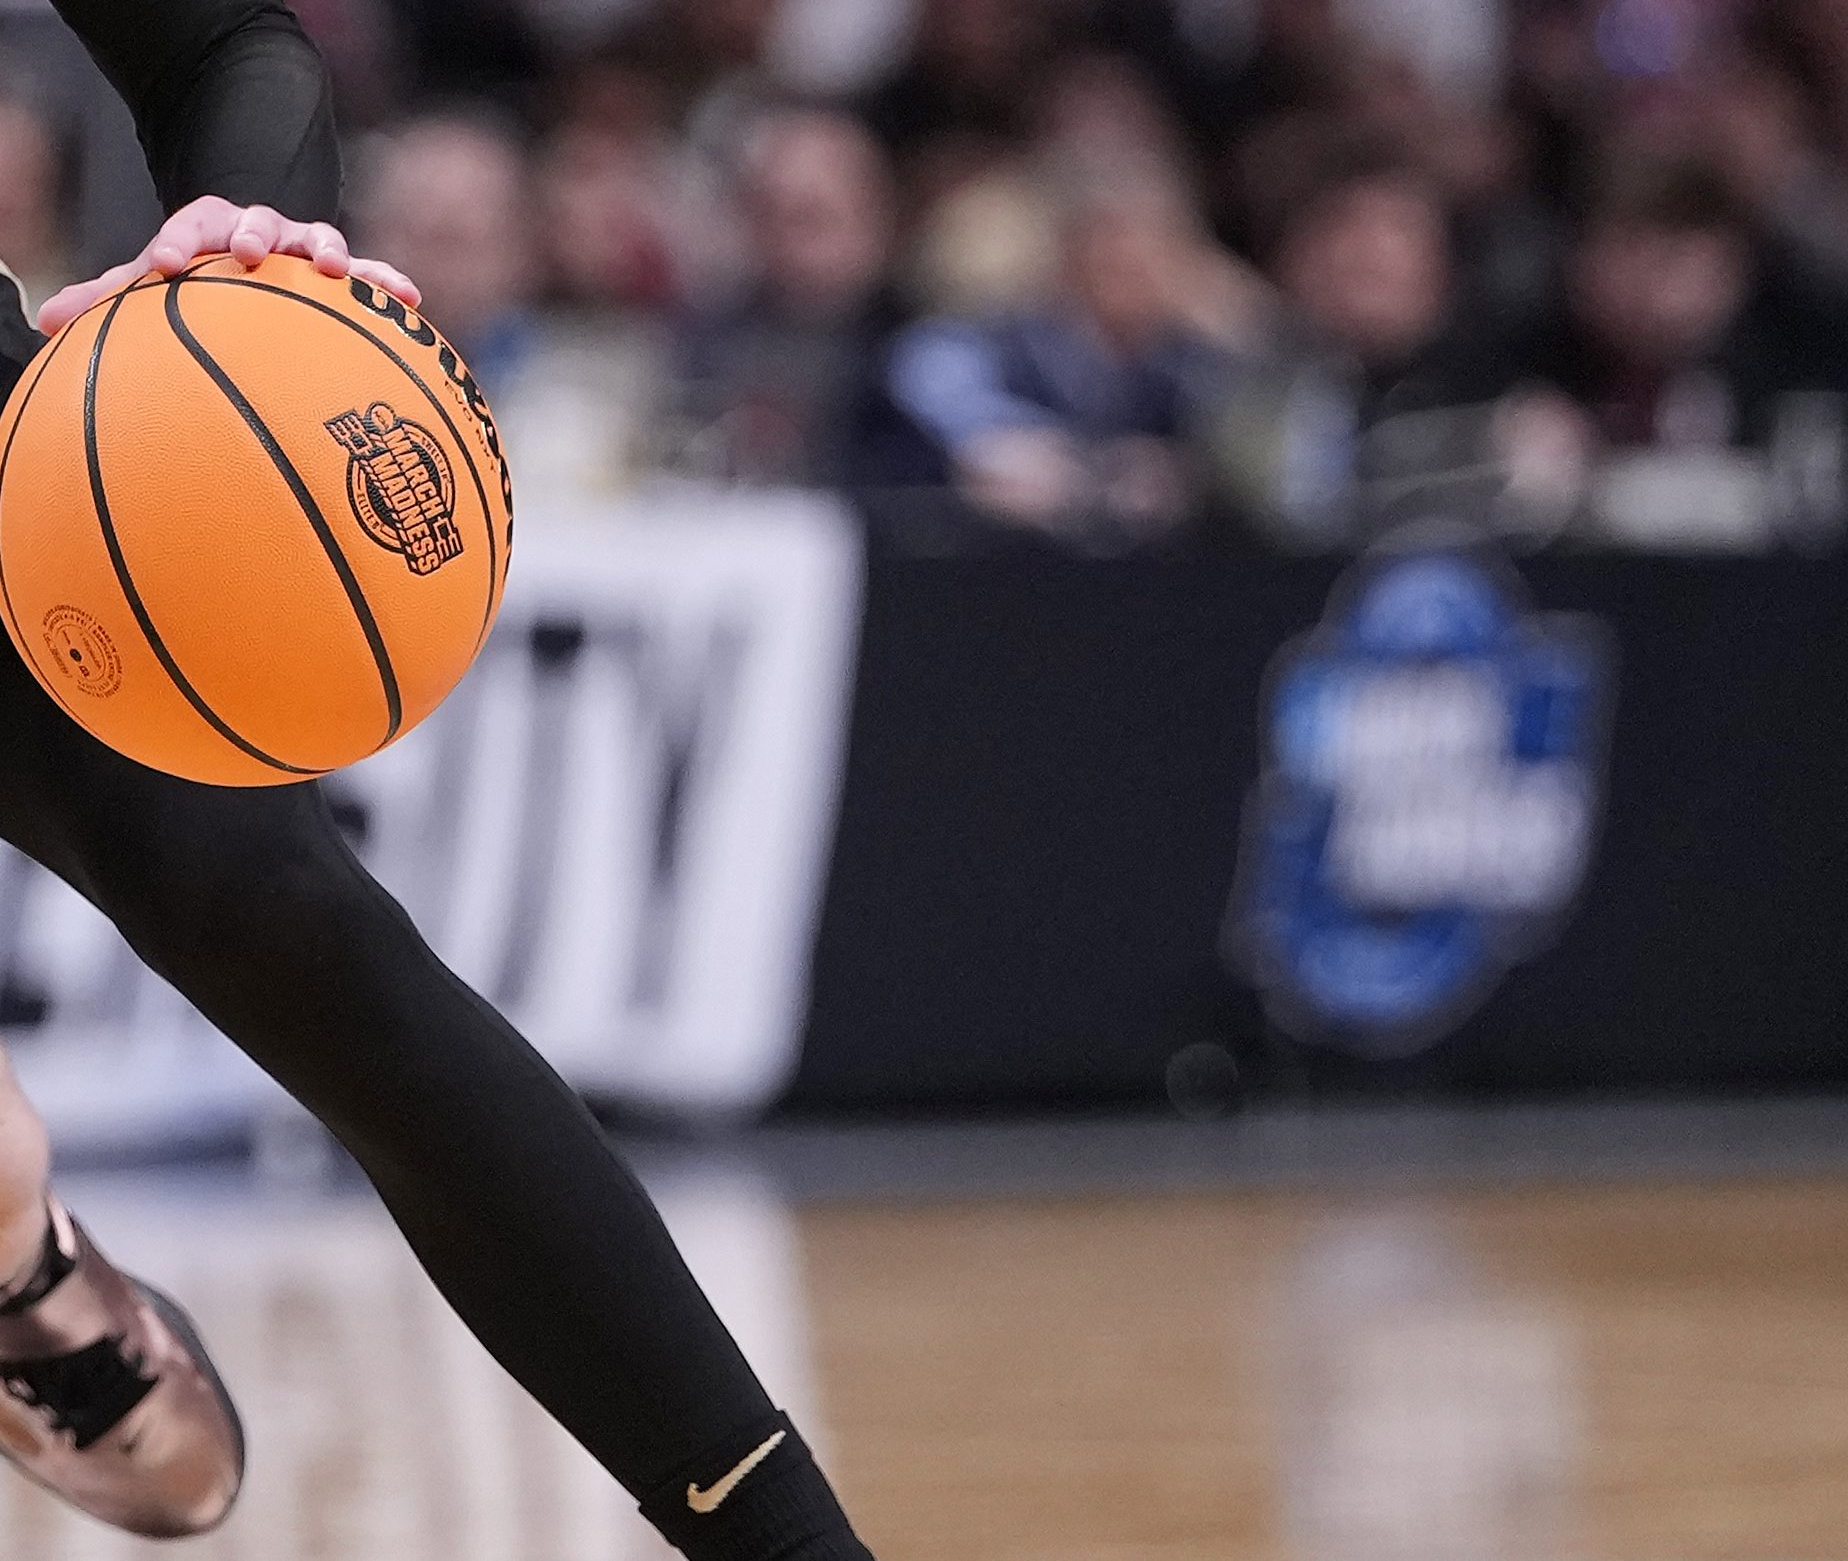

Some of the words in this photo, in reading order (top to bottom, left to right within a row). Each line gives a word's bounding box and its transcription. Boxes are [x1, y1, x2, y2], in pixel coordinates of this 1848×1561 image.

[356, 493, 374, 521] ELITE
[368, 450, 438, 574] MADNESS
[381, 428, 446, 519] MARCH
